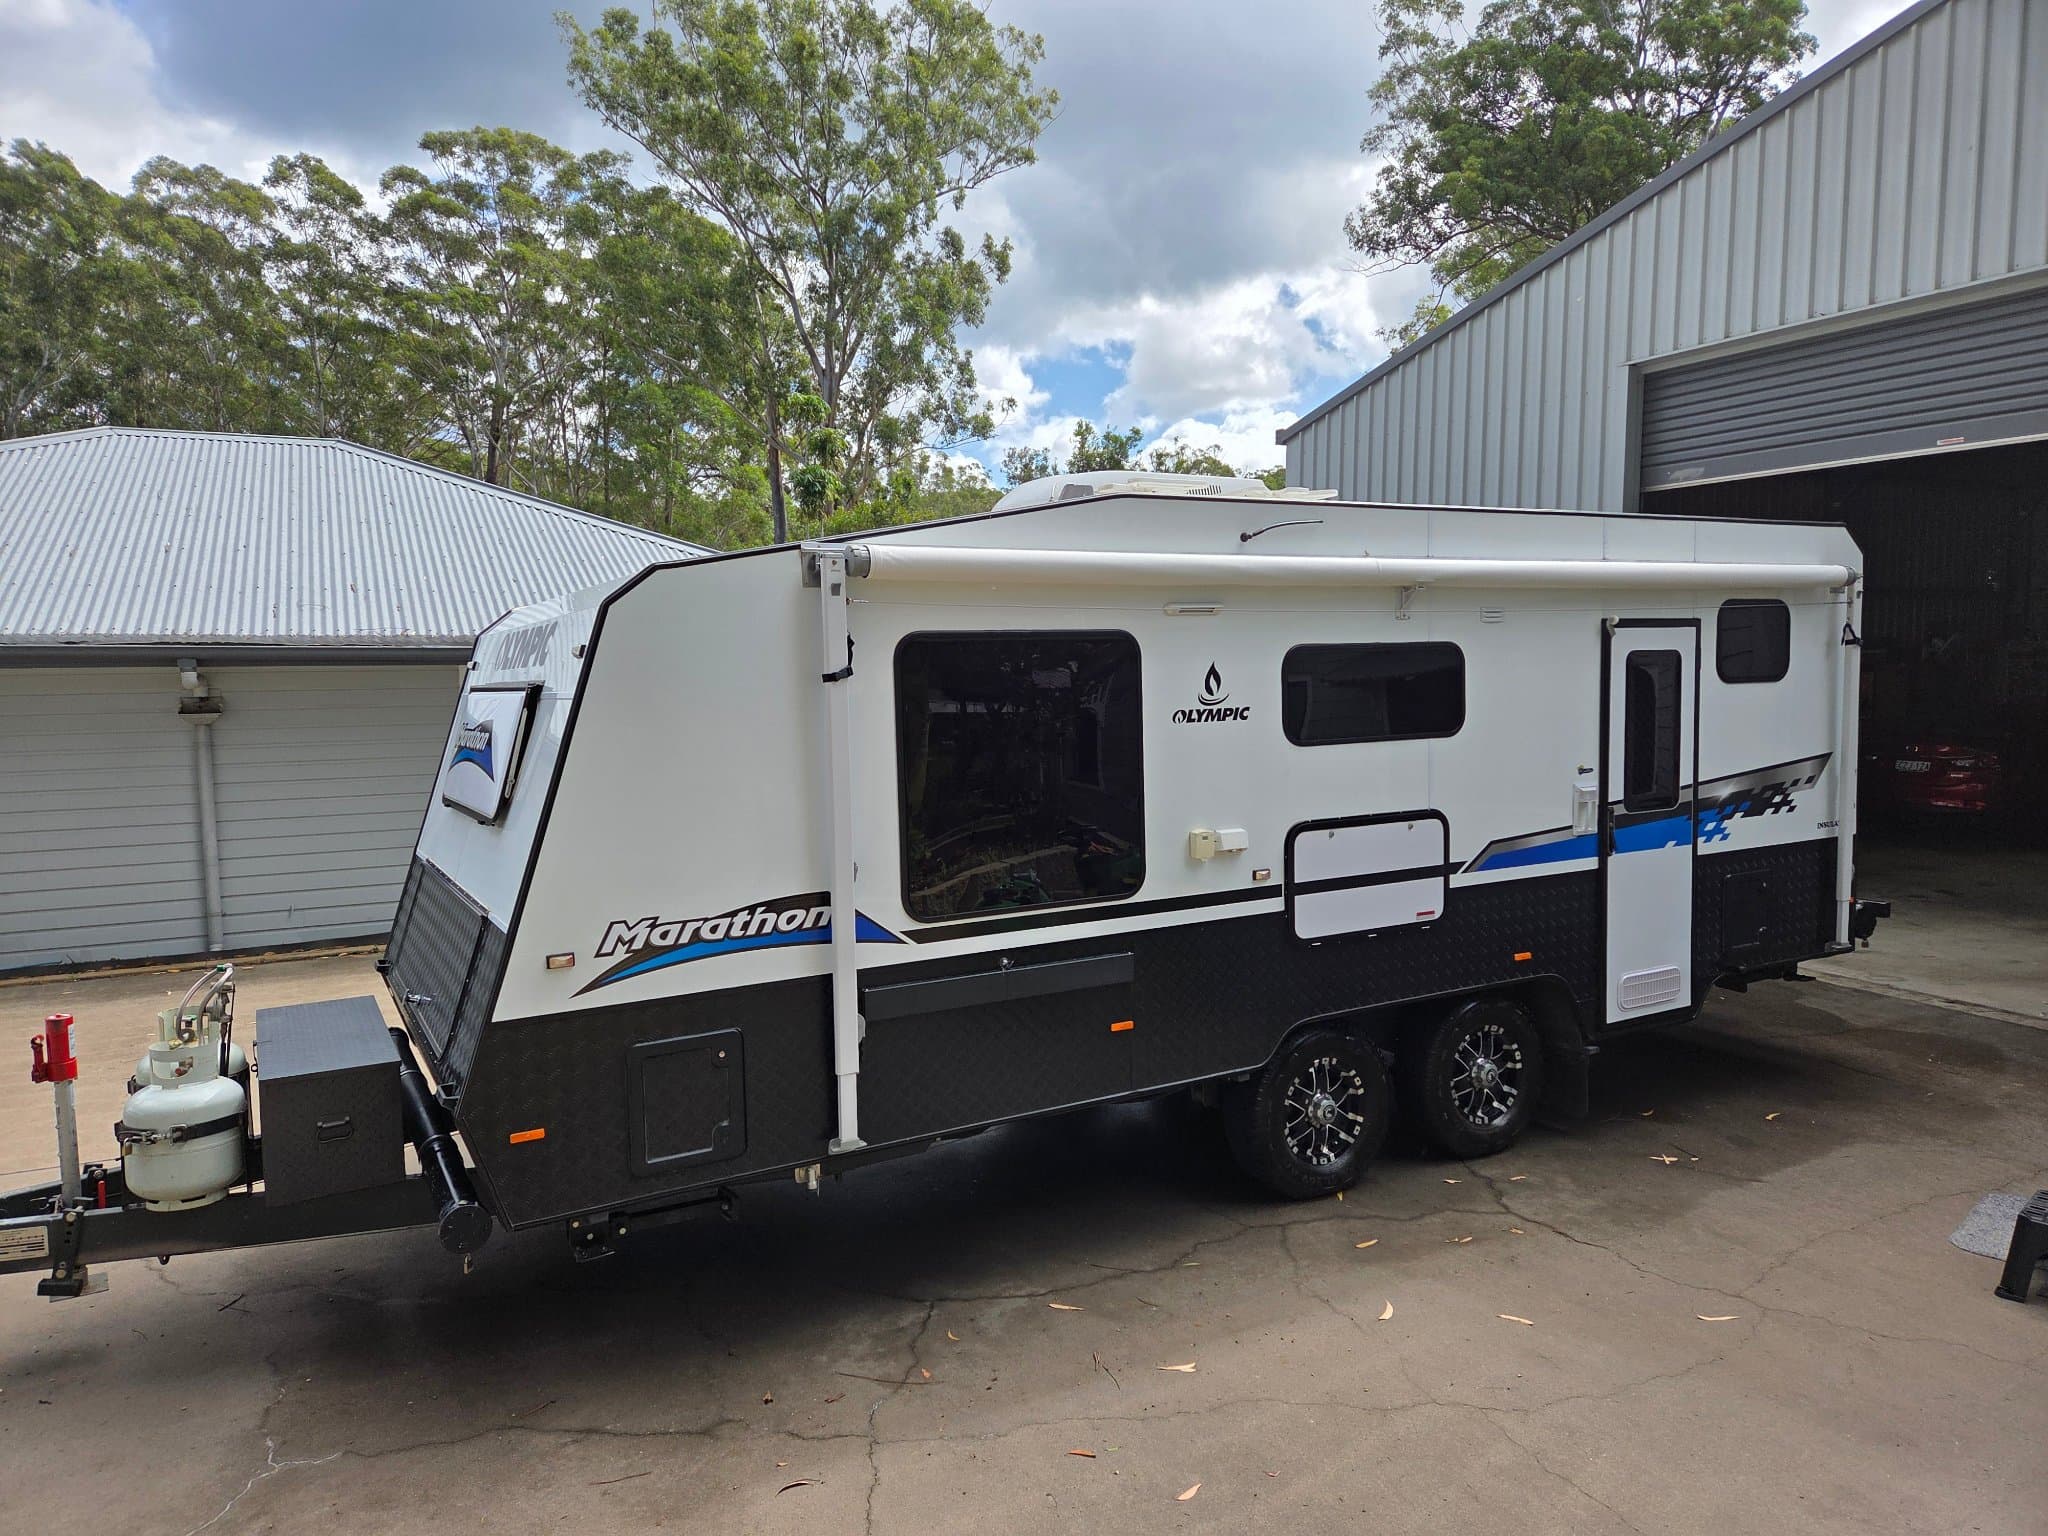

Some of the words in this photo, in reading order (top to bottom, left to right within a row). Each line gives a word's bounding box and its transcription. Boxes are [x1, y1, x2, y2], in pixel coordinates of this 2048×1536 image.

[495, 621, 559, 671] OLYMPIC
[1172, 706, 1251, 724] OLYMPIC
[1816, 820, 1840, 830] INSULA
[594, 905, 833, 958] Marathon
